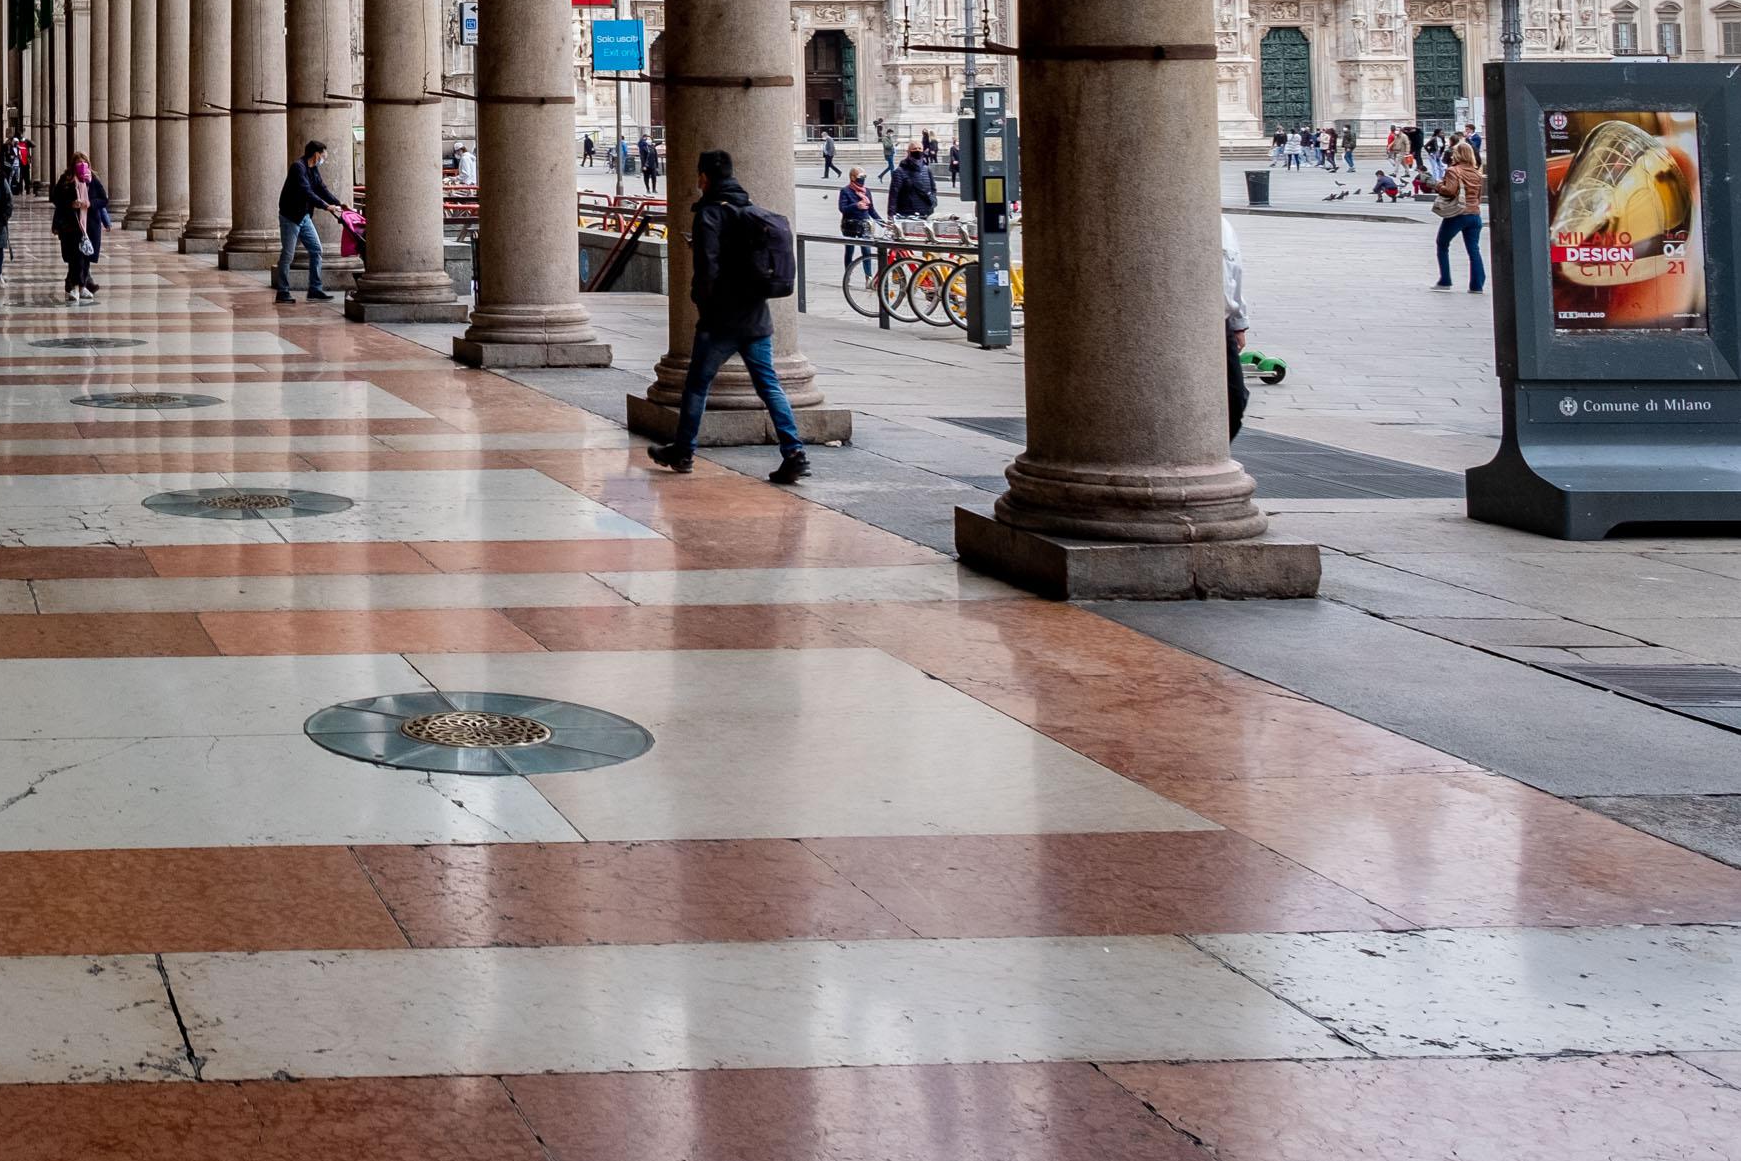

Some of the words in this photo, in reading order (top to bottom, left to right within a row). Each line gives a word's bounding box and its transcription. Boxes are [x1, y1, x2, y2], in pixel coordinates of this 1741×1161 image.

[596, 35, 614, 43] Solo
[603, 47, 619, 57] Exit
[620, 47, 638, 59] only
[1558, 231, 1632, 245] MILANO
[1566, 247, 1634, 262] DESIGN
[1663, 243, 1686, 257] 04
[1580, 263, 1634, 277] CITY
[1667, 261, 1685, 275] 21
[1583, 399, 1640, 412] Comune
[1645, 398, 1658, 411] di
[1664, 398, 1712, 411] Milano
